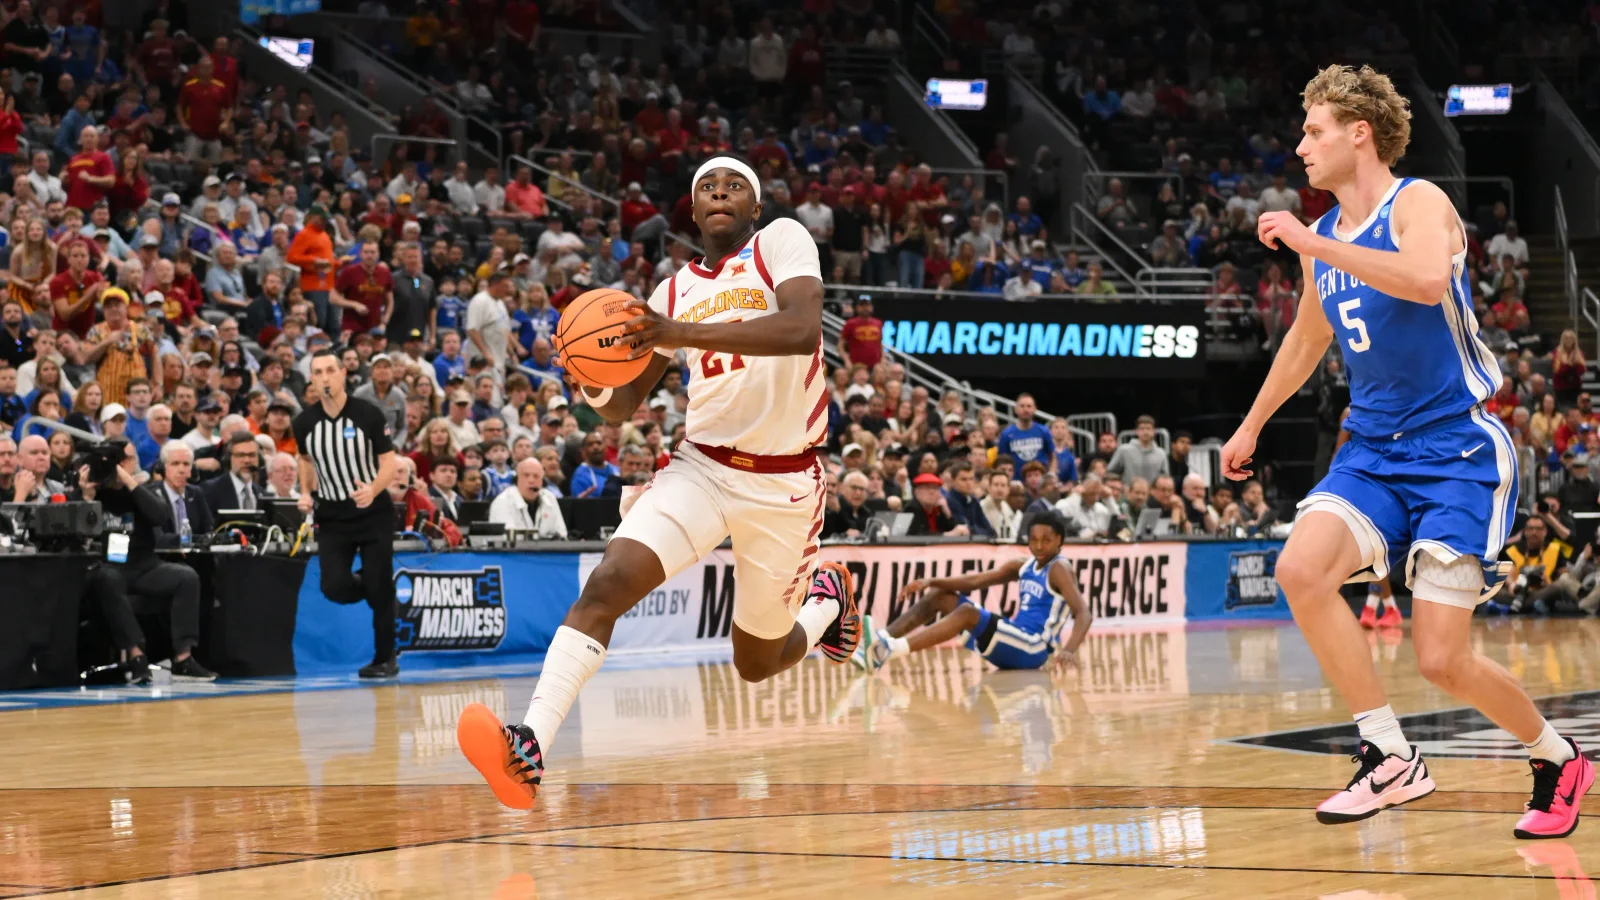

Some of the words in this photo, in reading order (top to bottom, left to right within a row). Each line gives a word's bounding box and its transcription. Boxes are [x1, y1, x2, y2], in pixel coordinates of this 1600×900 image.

[677, 288, 768, 323] YCLONES
[1337, 297, 1371, 353] 5
[412, 576, 474, 607] MARCH
[669, 588, 690, 615] BY
[419, 607, 505, 638] MADNESS
